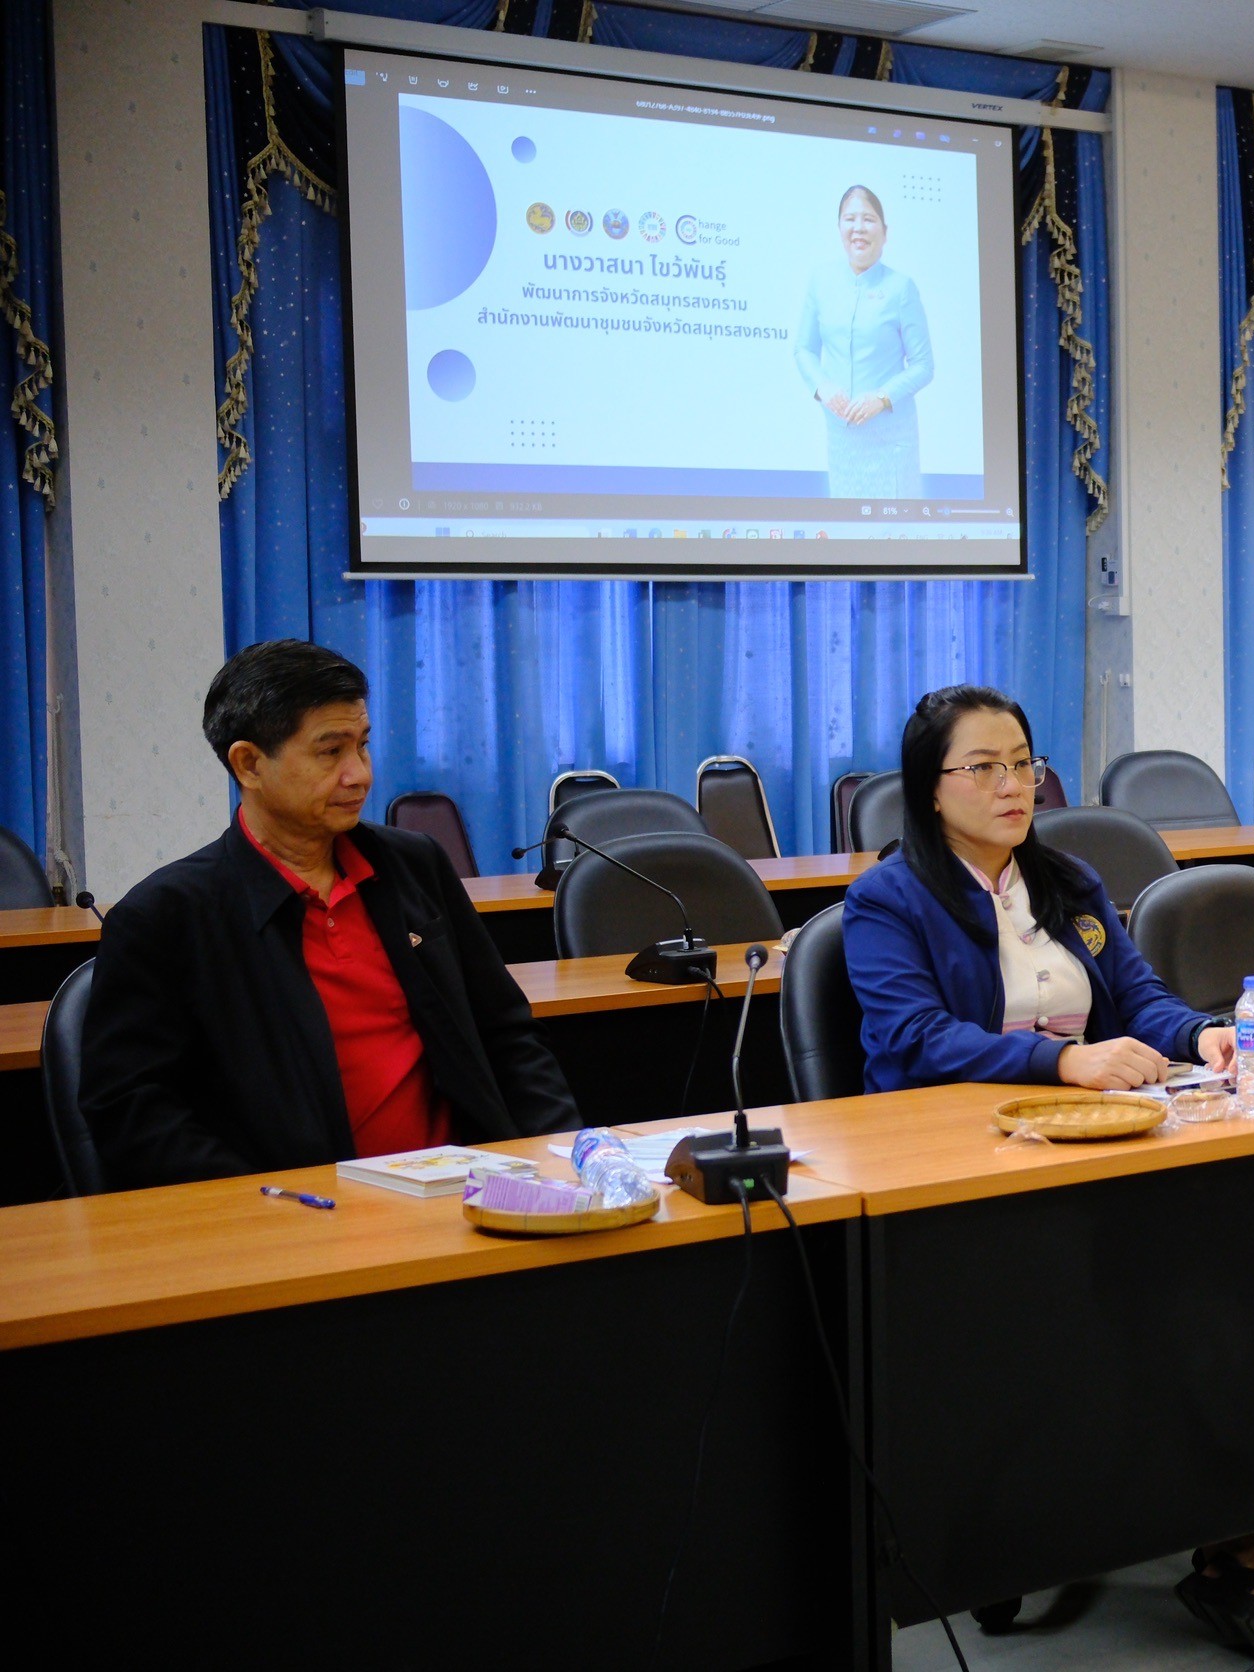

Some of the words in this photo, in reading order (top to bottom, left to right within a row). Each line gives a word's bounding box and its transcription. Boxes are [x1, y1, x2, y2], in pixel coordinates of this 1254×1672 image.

[972, 103, 1003, 112] VERTEX
[698, 234, 712, 244] for
[714, 235, 740, 247] Good
[543, 252, 644, 276] นางวาสนา
[650, 253, 727, 286] ไขว้พันธุ์
[522, 281, 748, 312] พัฒนาการจังหวัดสมุทรสงคราม
[477, 306, 789, 341] สำนักงานพัฒนาชุมชนจังหวัดสมุทรสงคราม
[883, 507, 898, 516] 81%
